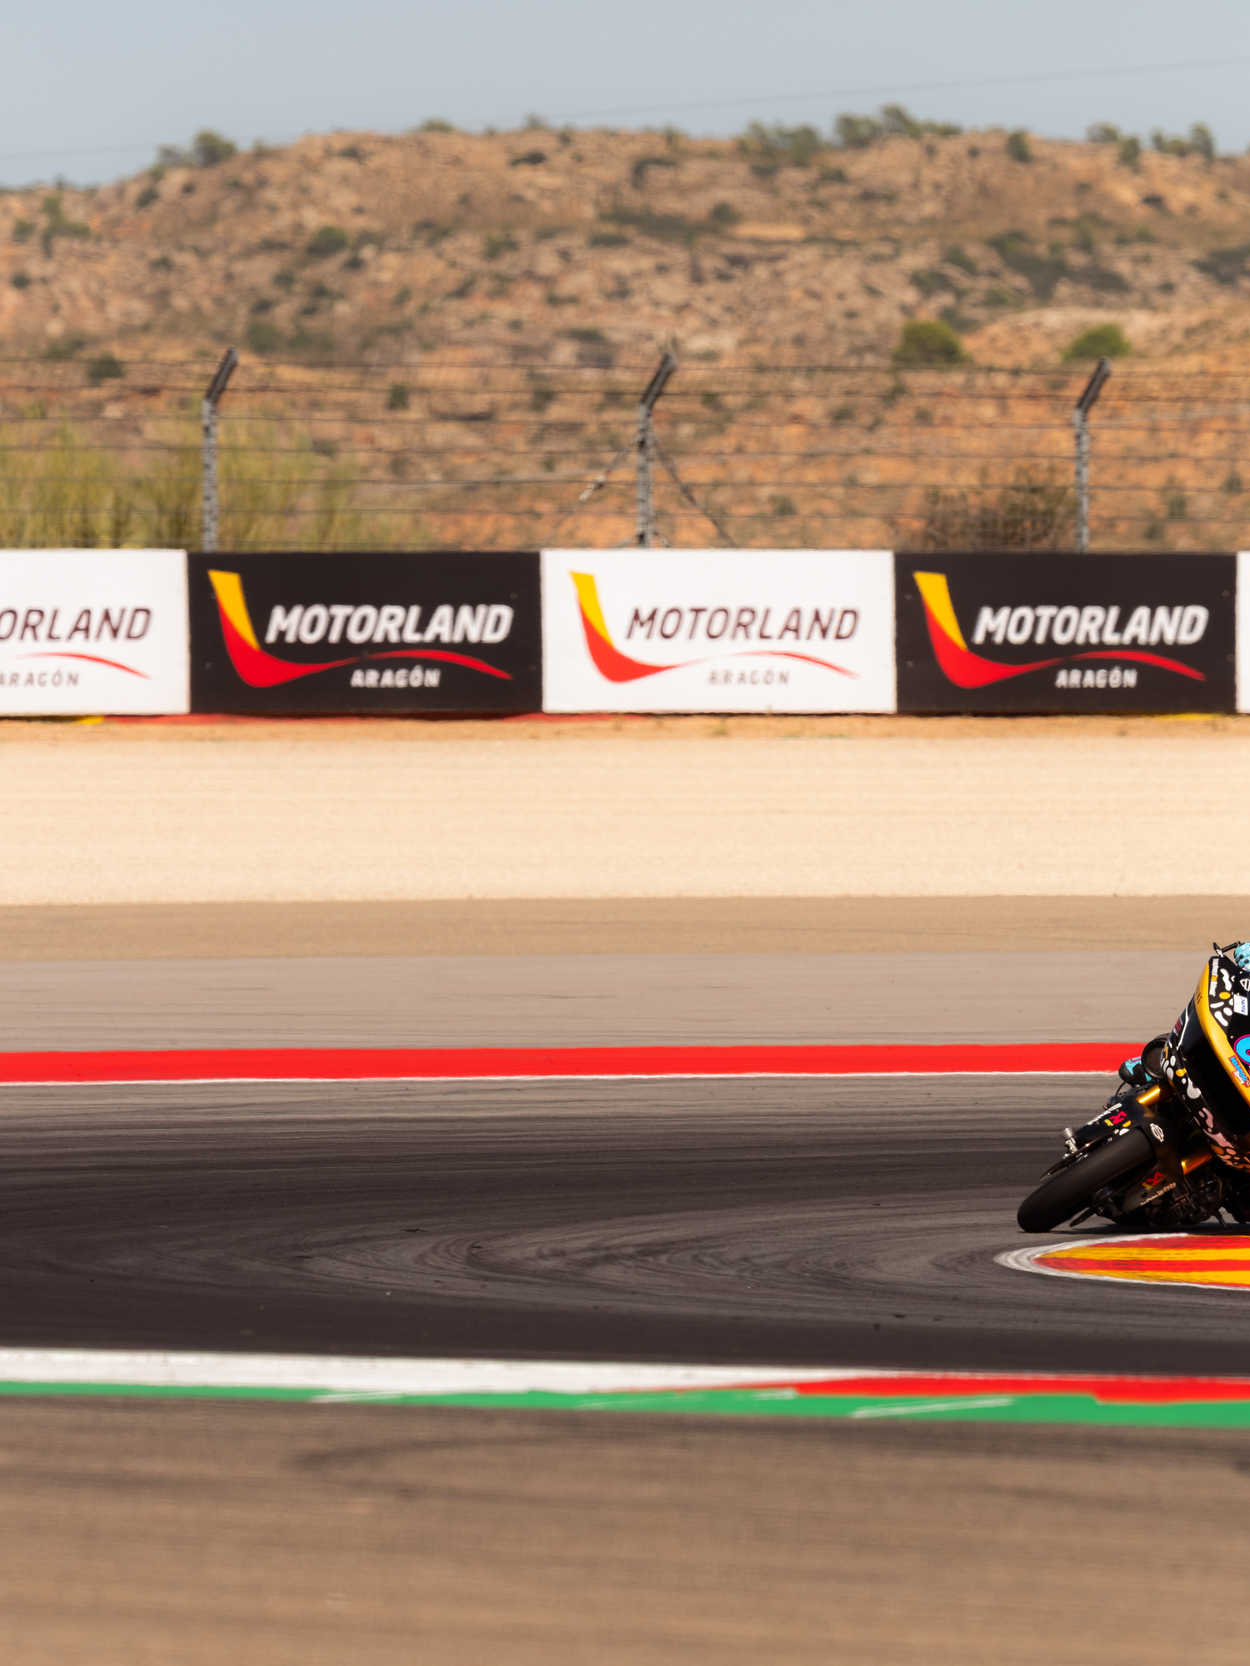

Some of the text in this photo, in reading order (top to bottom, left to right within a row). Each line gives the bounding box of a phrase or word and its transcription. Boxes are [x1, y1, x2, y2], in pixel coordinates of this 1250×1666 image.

[266, 604, 514, 644] MOTORLAND
[626, 607, 859, 641] MOTORLAND
[973, 605, 1209, 645] MOTORLAND
[351, 666, 441, 687] ARAGÓN
[707, 668, 790, 687] ARAGÓN
[1056, 667, 1138, 688] ARAGÓN
